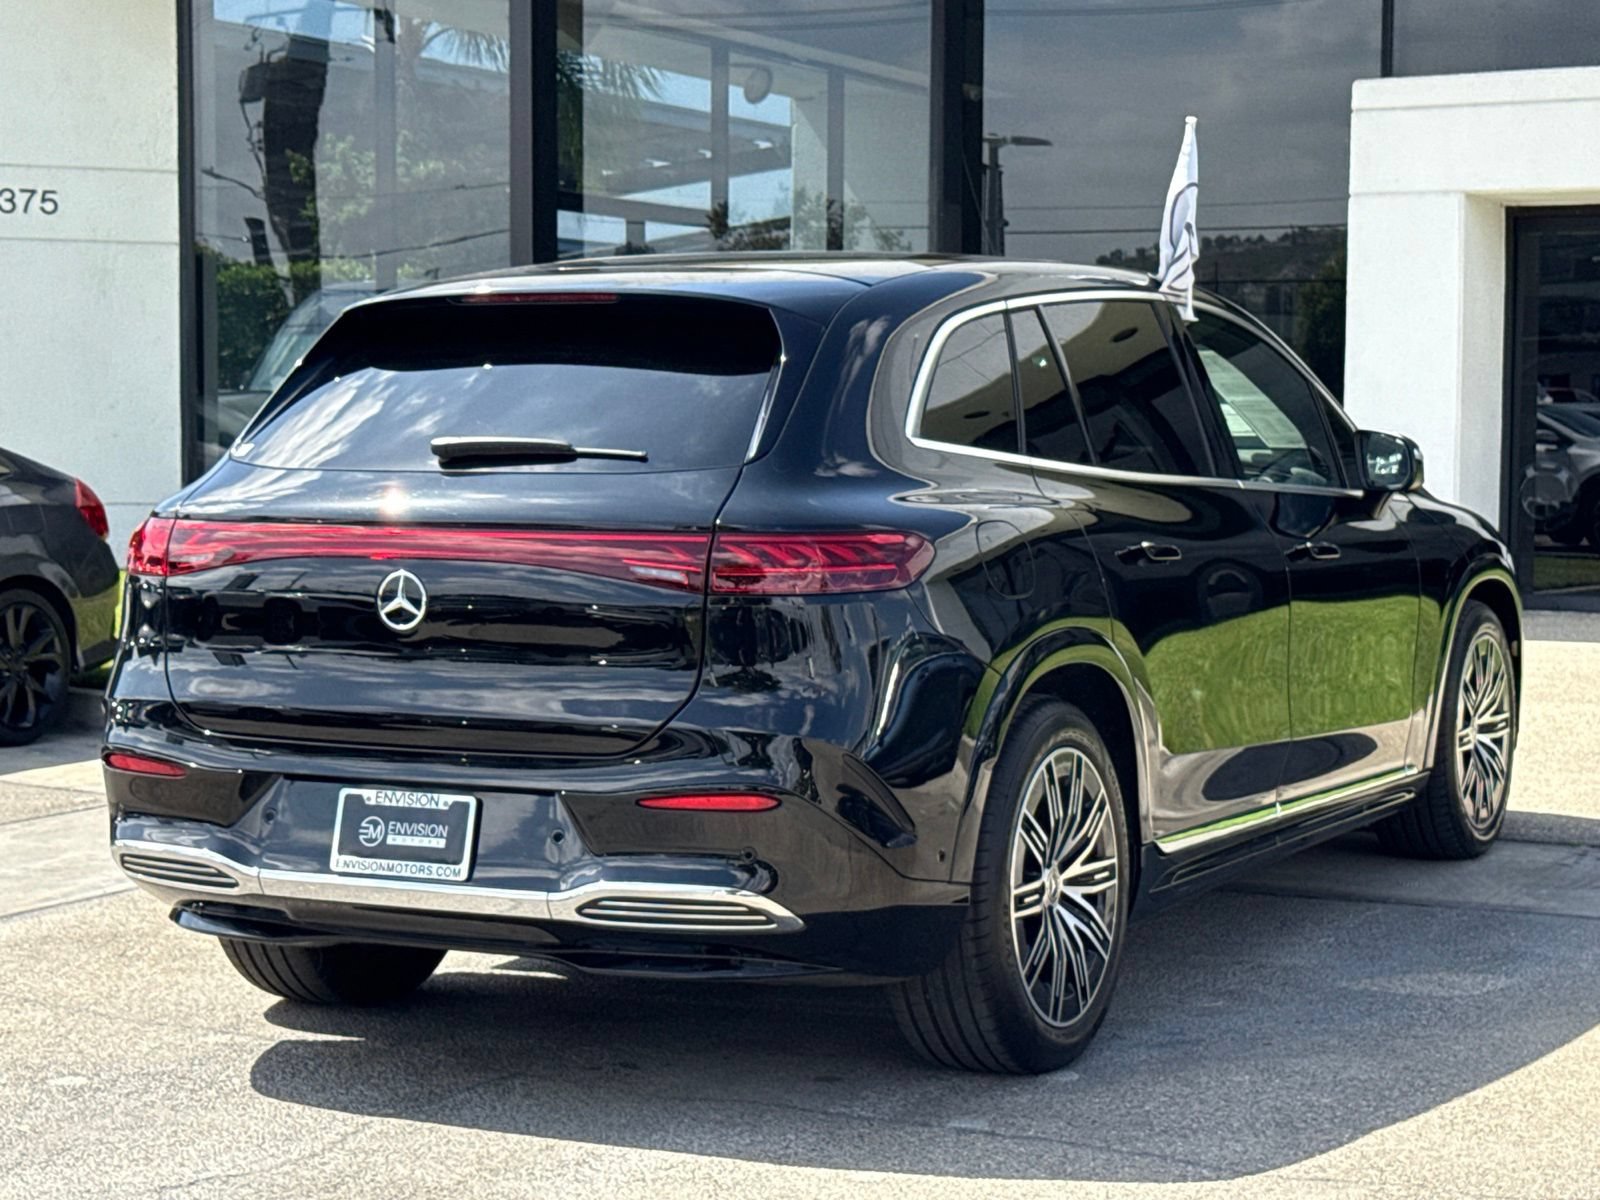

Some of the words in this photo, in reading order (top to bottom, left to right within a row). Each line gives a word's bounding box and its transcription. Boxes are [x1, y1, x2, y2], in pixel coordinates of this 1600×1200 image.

[0, 187, 59, 216] 375
[375, 790, 440, 808] ENVISION
[388, 820, 449, 838] ENVISION
